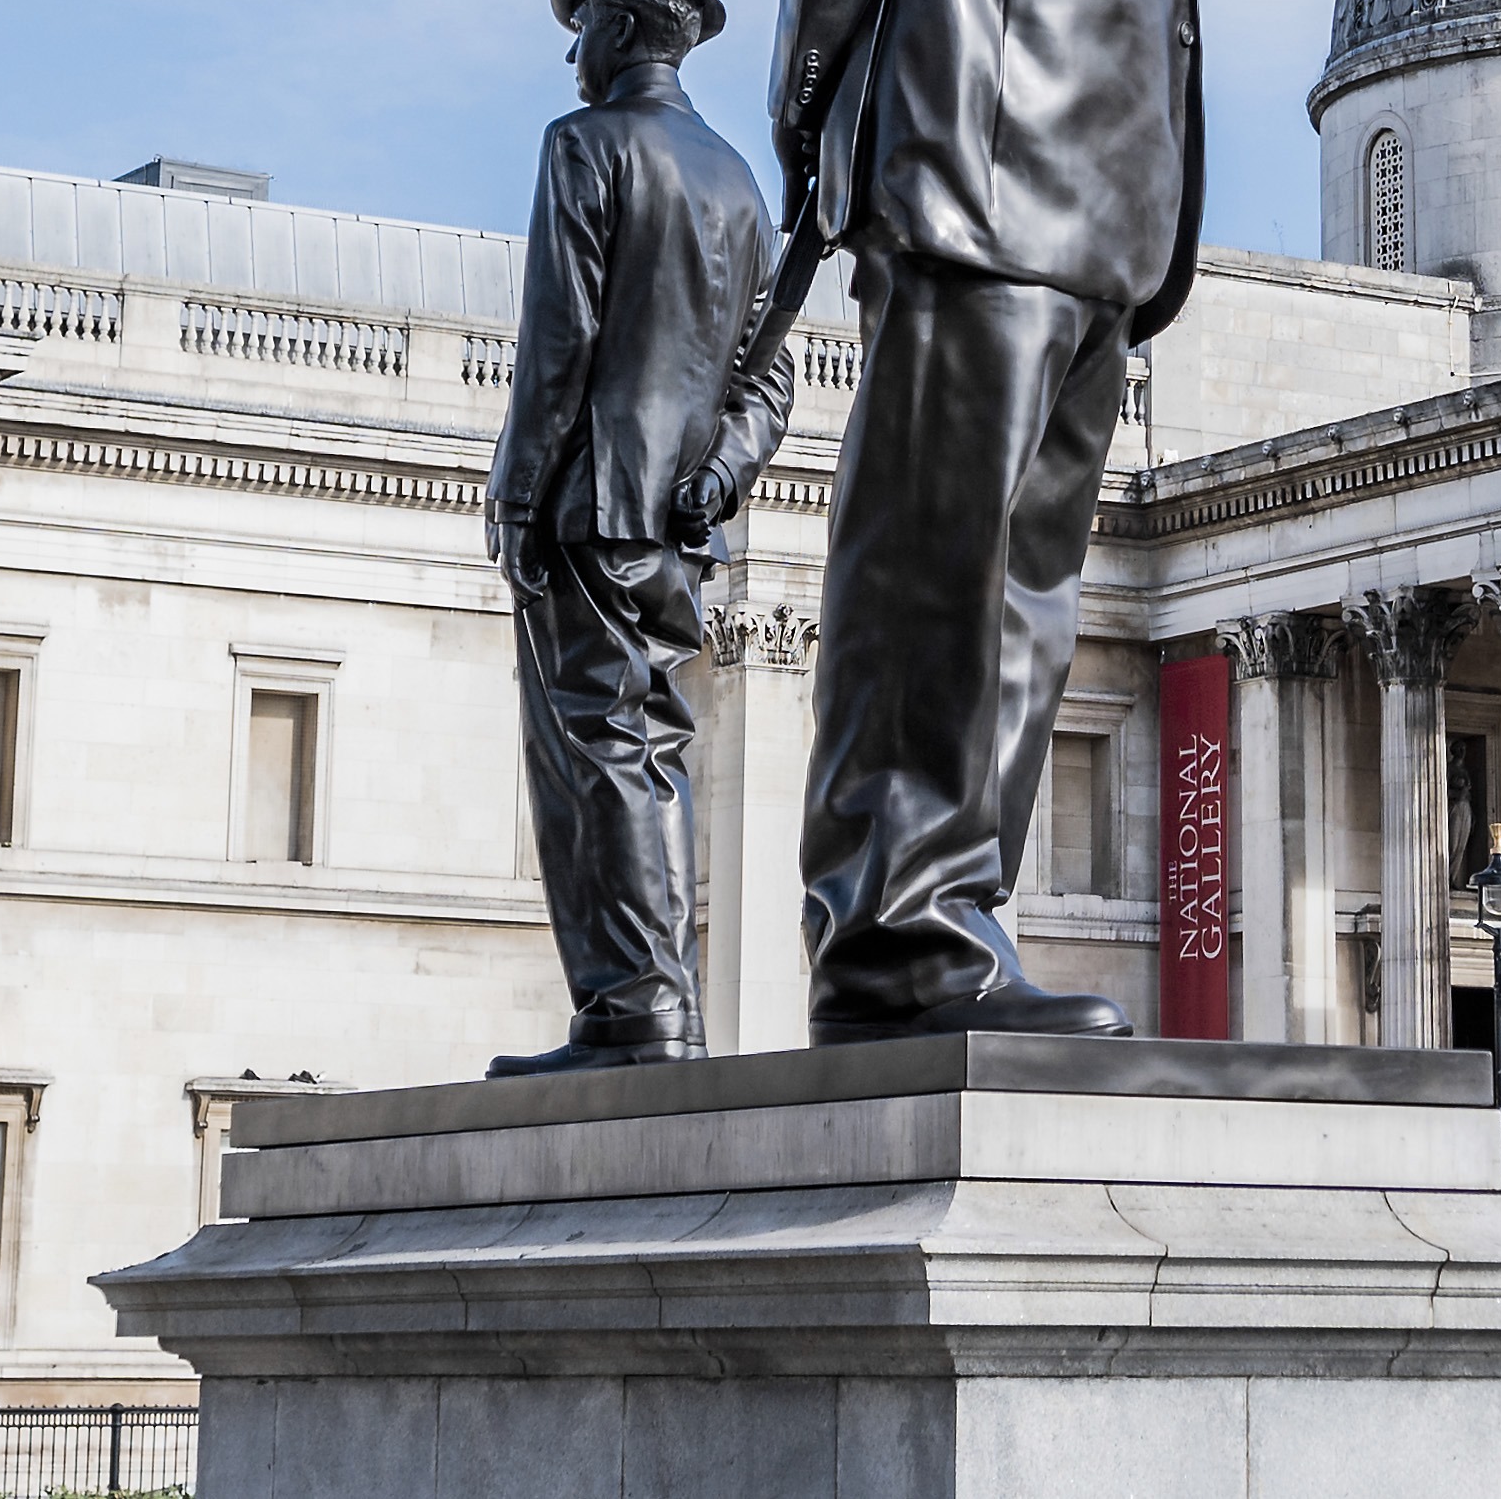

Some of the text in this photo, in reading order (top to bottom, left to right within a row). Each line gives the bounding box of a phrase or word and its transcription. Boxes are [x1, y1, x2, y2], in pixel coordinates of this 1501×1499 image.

[1168, 860, 1178, 902] THE
[1179, 733, 1198, 961] NATIONAL
[1201, 733, 1223, 960] GALLERY
